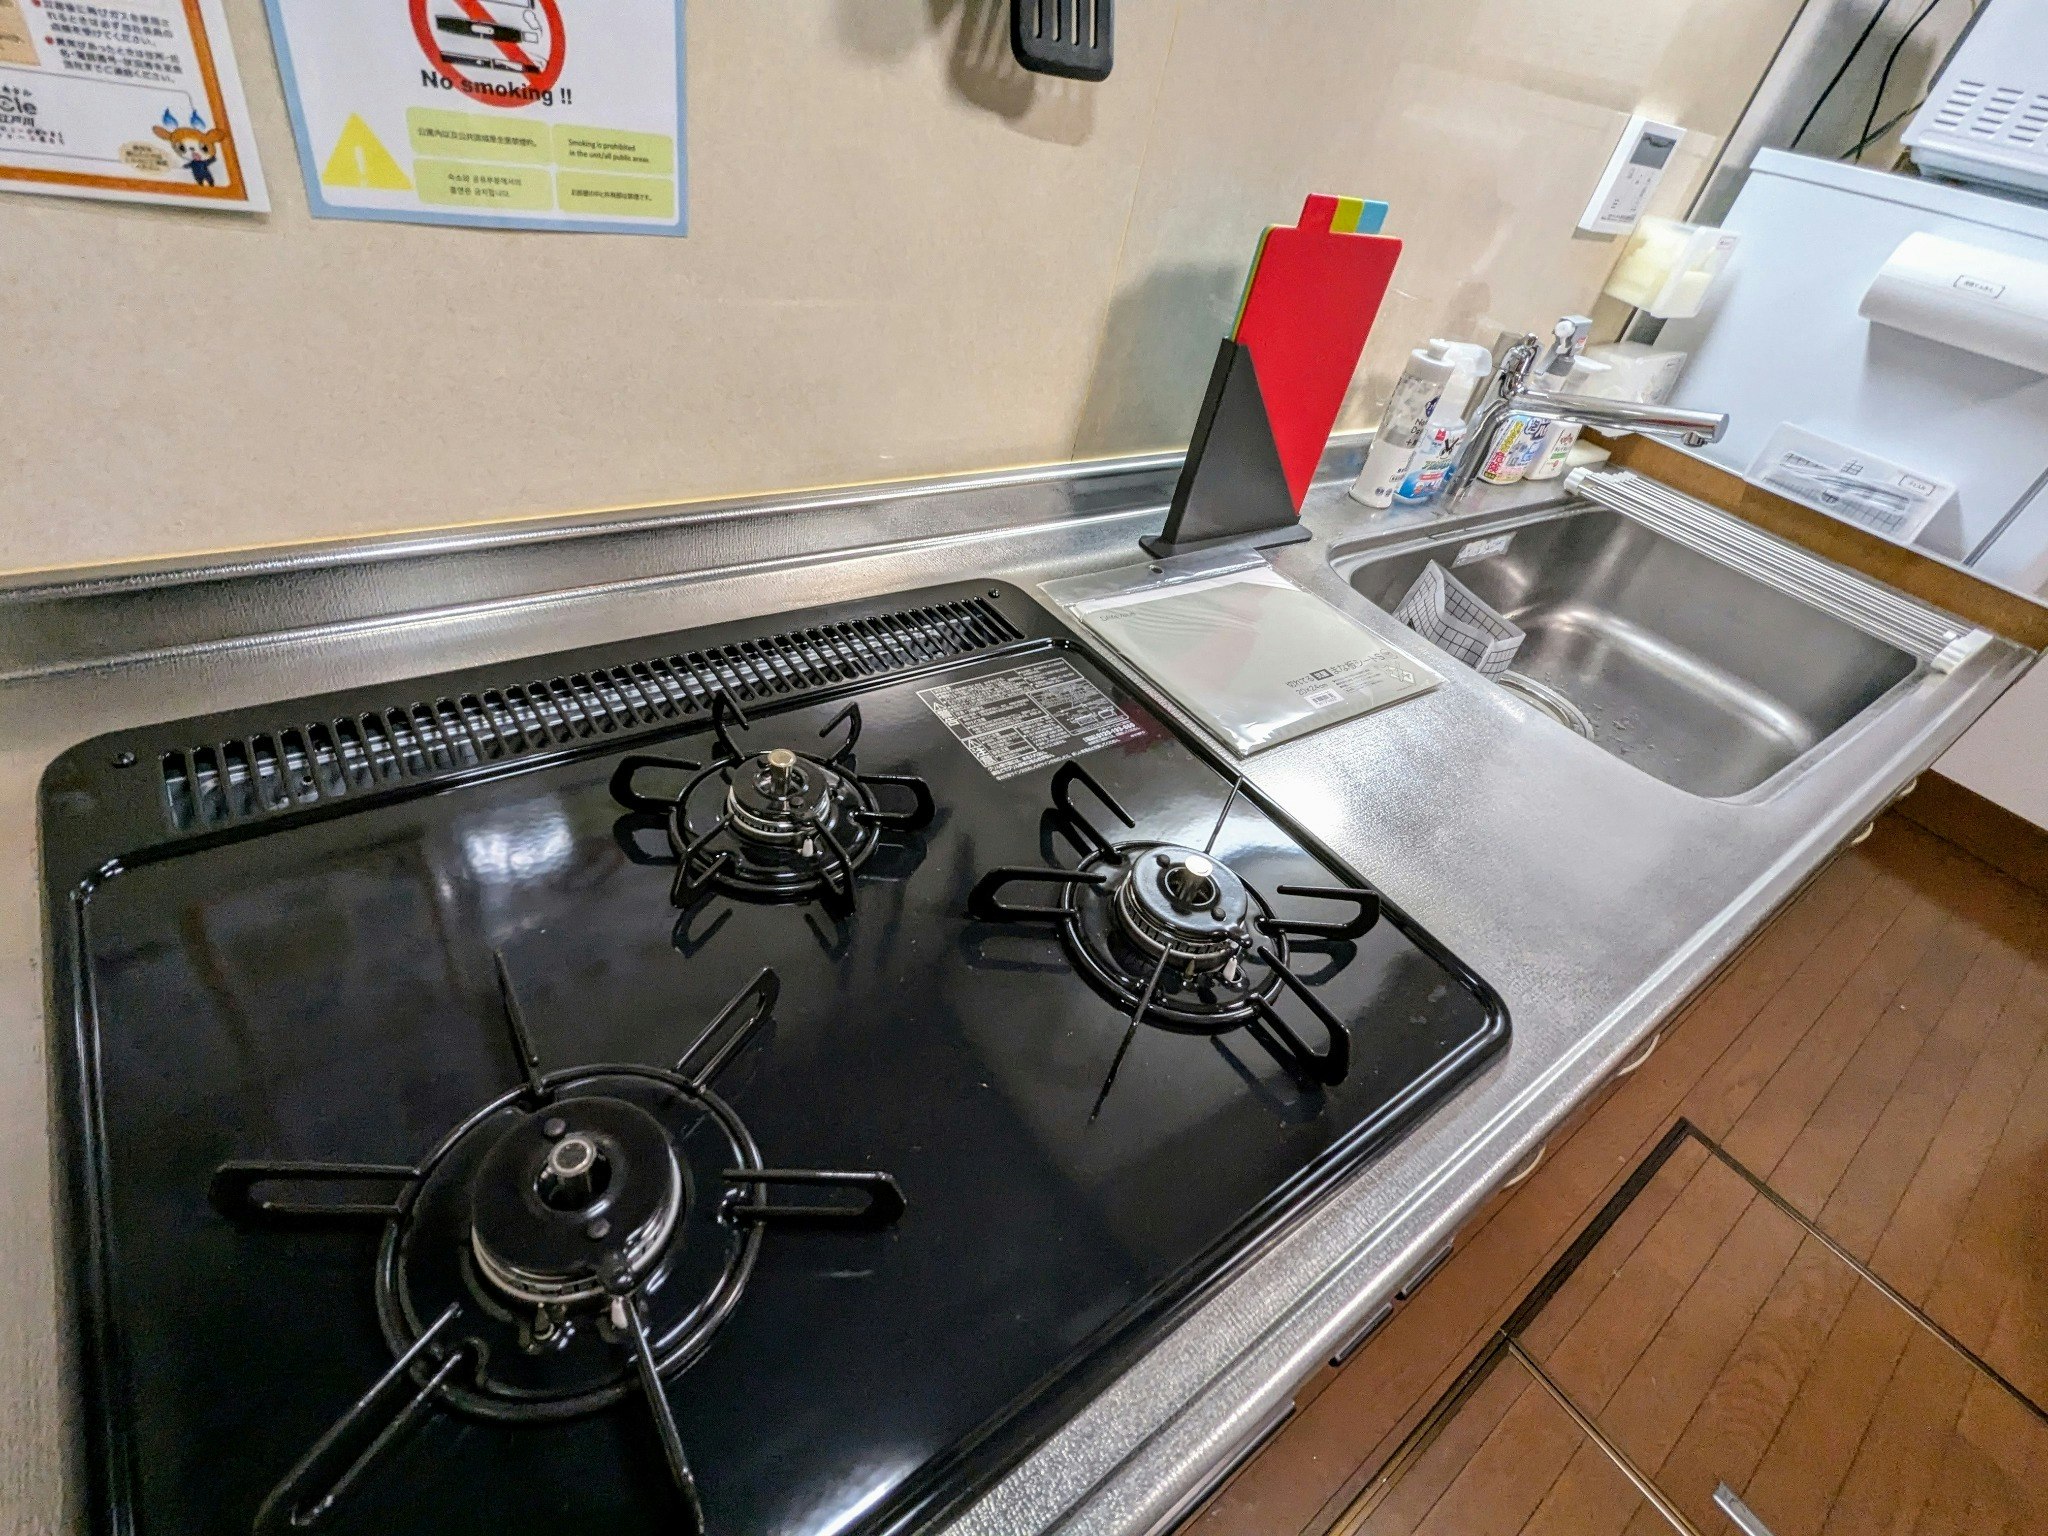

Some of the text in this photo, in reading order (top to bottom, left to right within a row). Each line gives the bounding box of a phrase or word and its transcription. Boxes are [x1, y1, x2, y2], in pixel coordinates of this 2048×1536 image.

[421, 69, 453, 90] No
[461, 79, 553, 106] smoking
[568, 139, 596, 149] Smoking
[603, 143, 636, 151] prohibited
